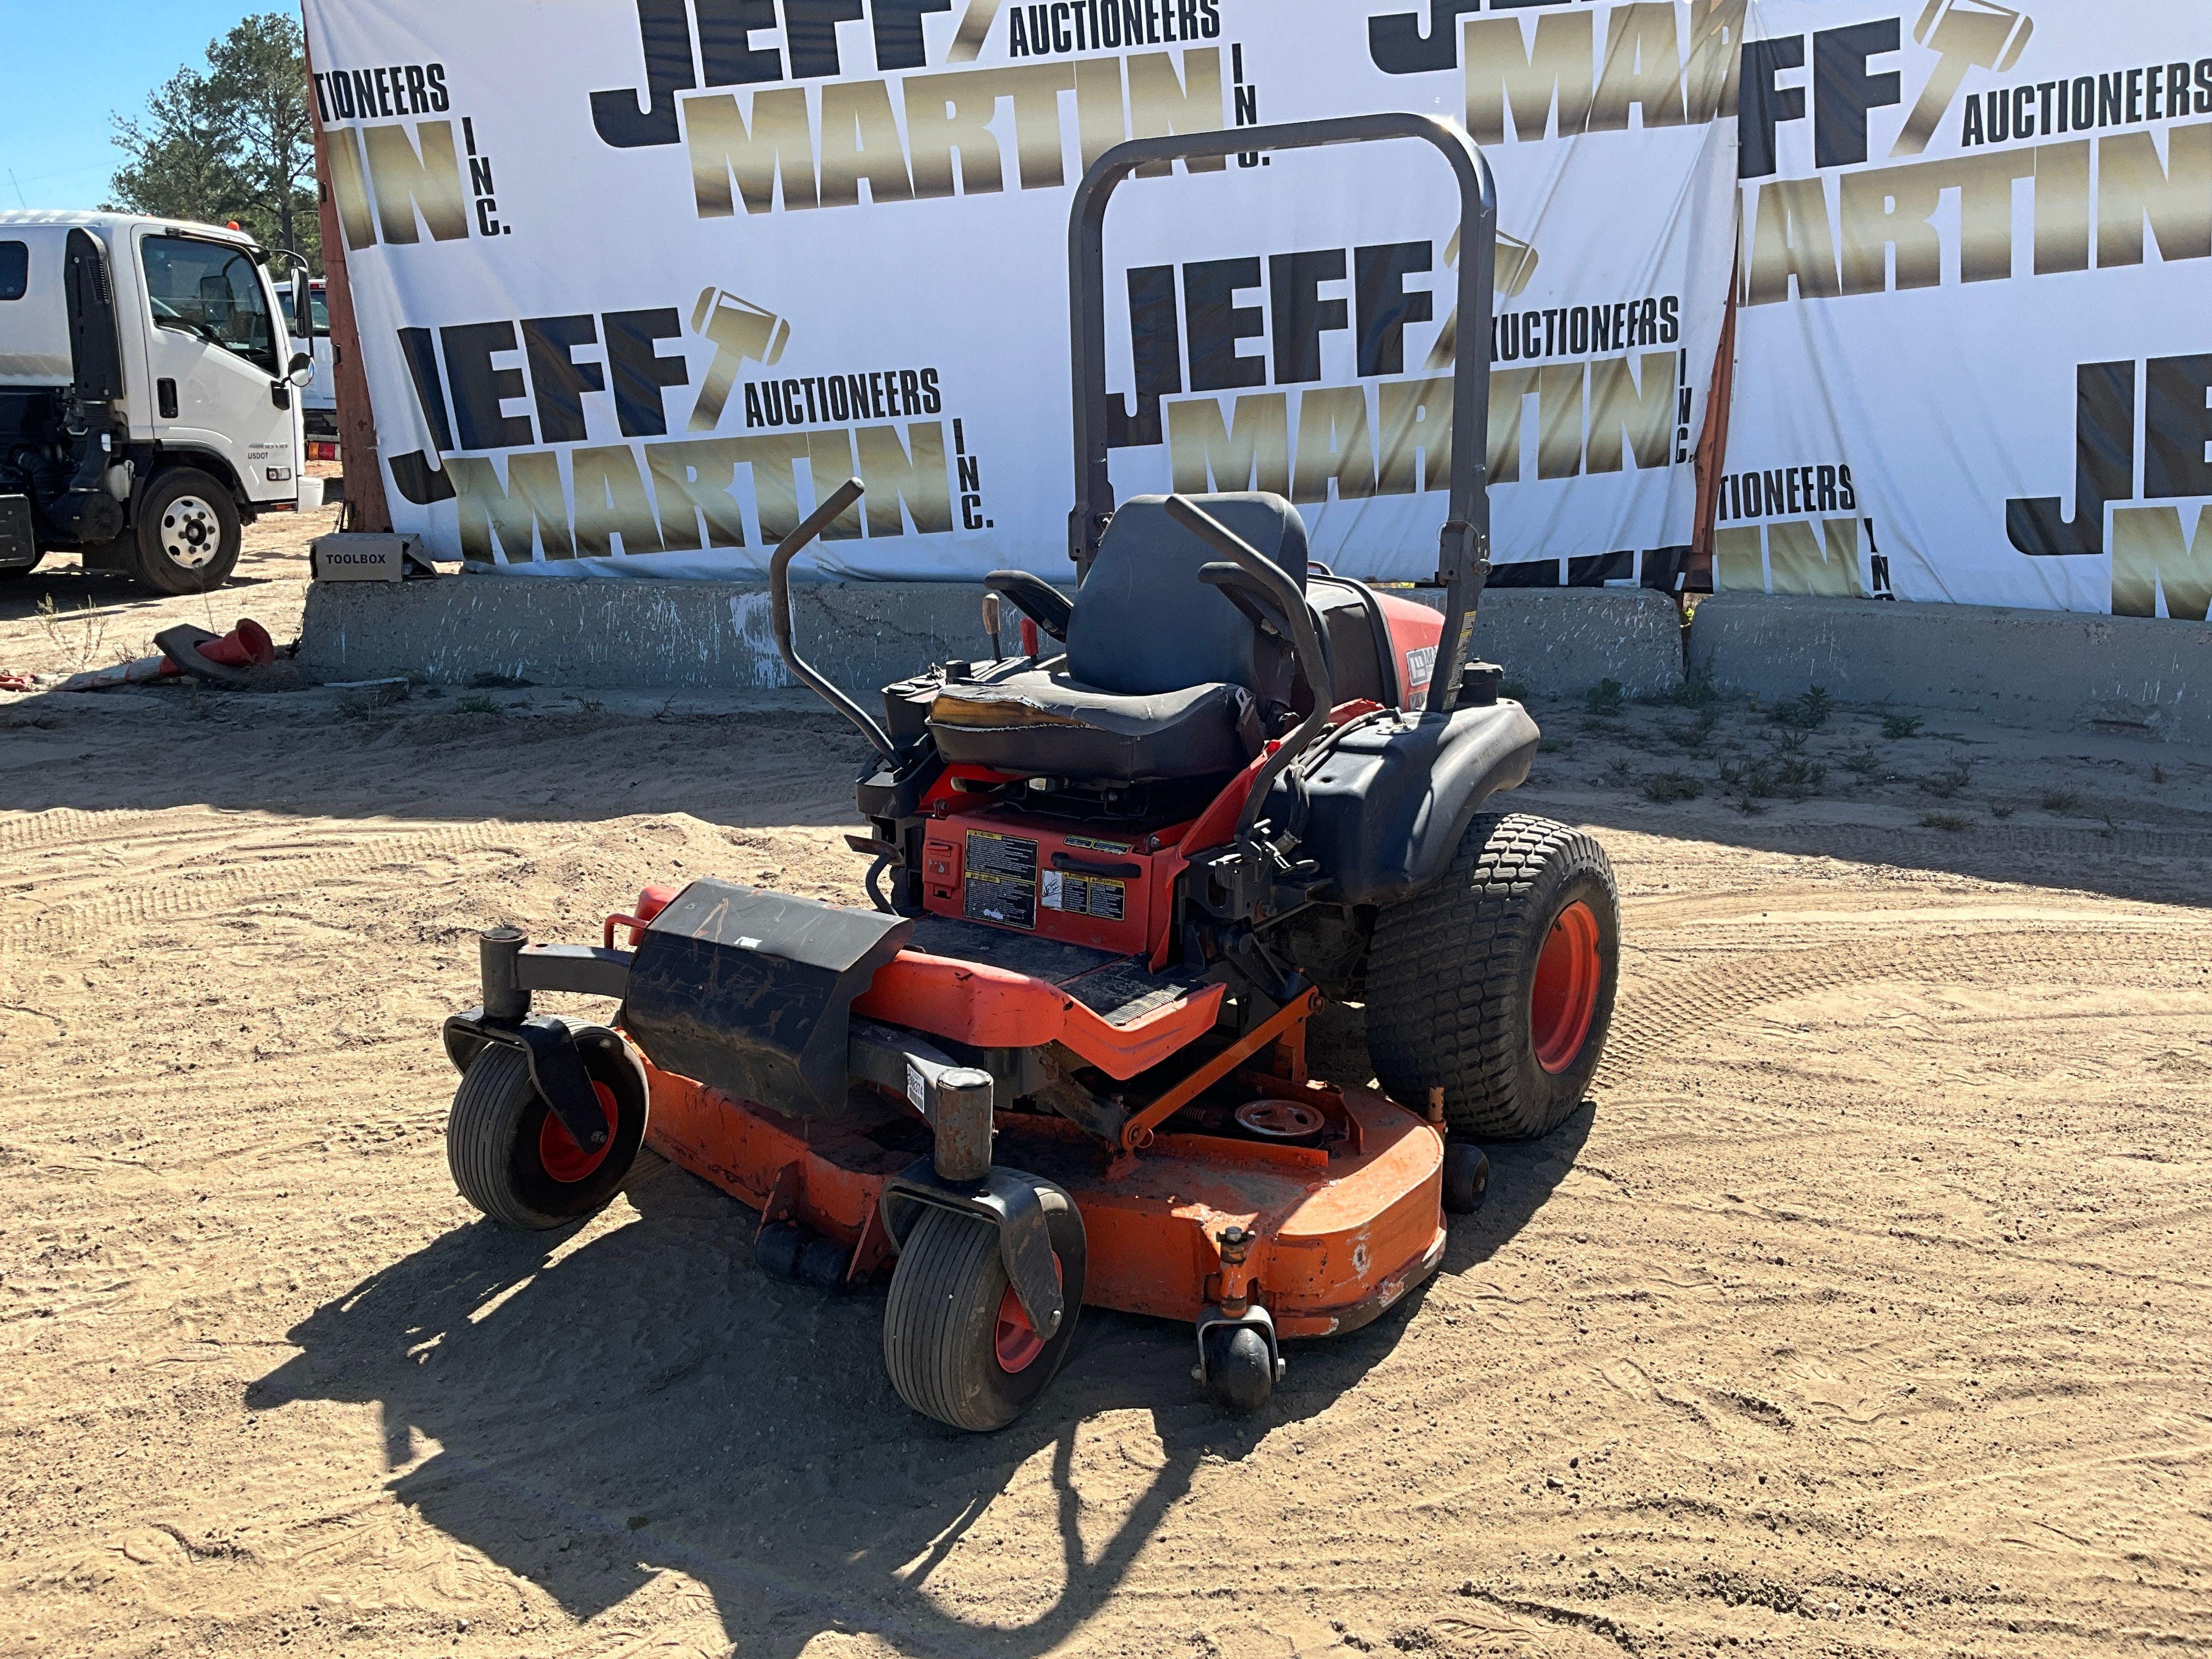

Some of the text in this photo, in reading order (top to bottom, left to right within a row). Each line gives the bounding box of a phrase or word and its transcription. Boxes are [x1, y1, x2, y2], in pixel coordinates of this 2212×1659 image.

[1010, 0, 1220, 57] AUCTIONEERS
[313, 63, 449, 122] TIONEERS
[682, 47, 1227, 218] MARTIN
[1961, 58, 2212, 147] AUCTIONEERS
[324, 120, 469, 251] IN
[462, 116, 511, 236] INC.
[1738, 122, 2212, 308] ARTIN
[744, 368, 941, 427] AUCTIONEERS
[1105, 240, 1432, 448] JEFF
[388, 307, 689, 504] JEFF
[1167, 351, 1676, 505] MARTIN
[441, 421, 953, 565] MARTIN
[953, 418, 994, 529] INC.
[1719, 464, 1855, 521] TIONEERS
[326, 554, 386, 564] TOOLBOX
[1864, 517, 1896, 601] IN
